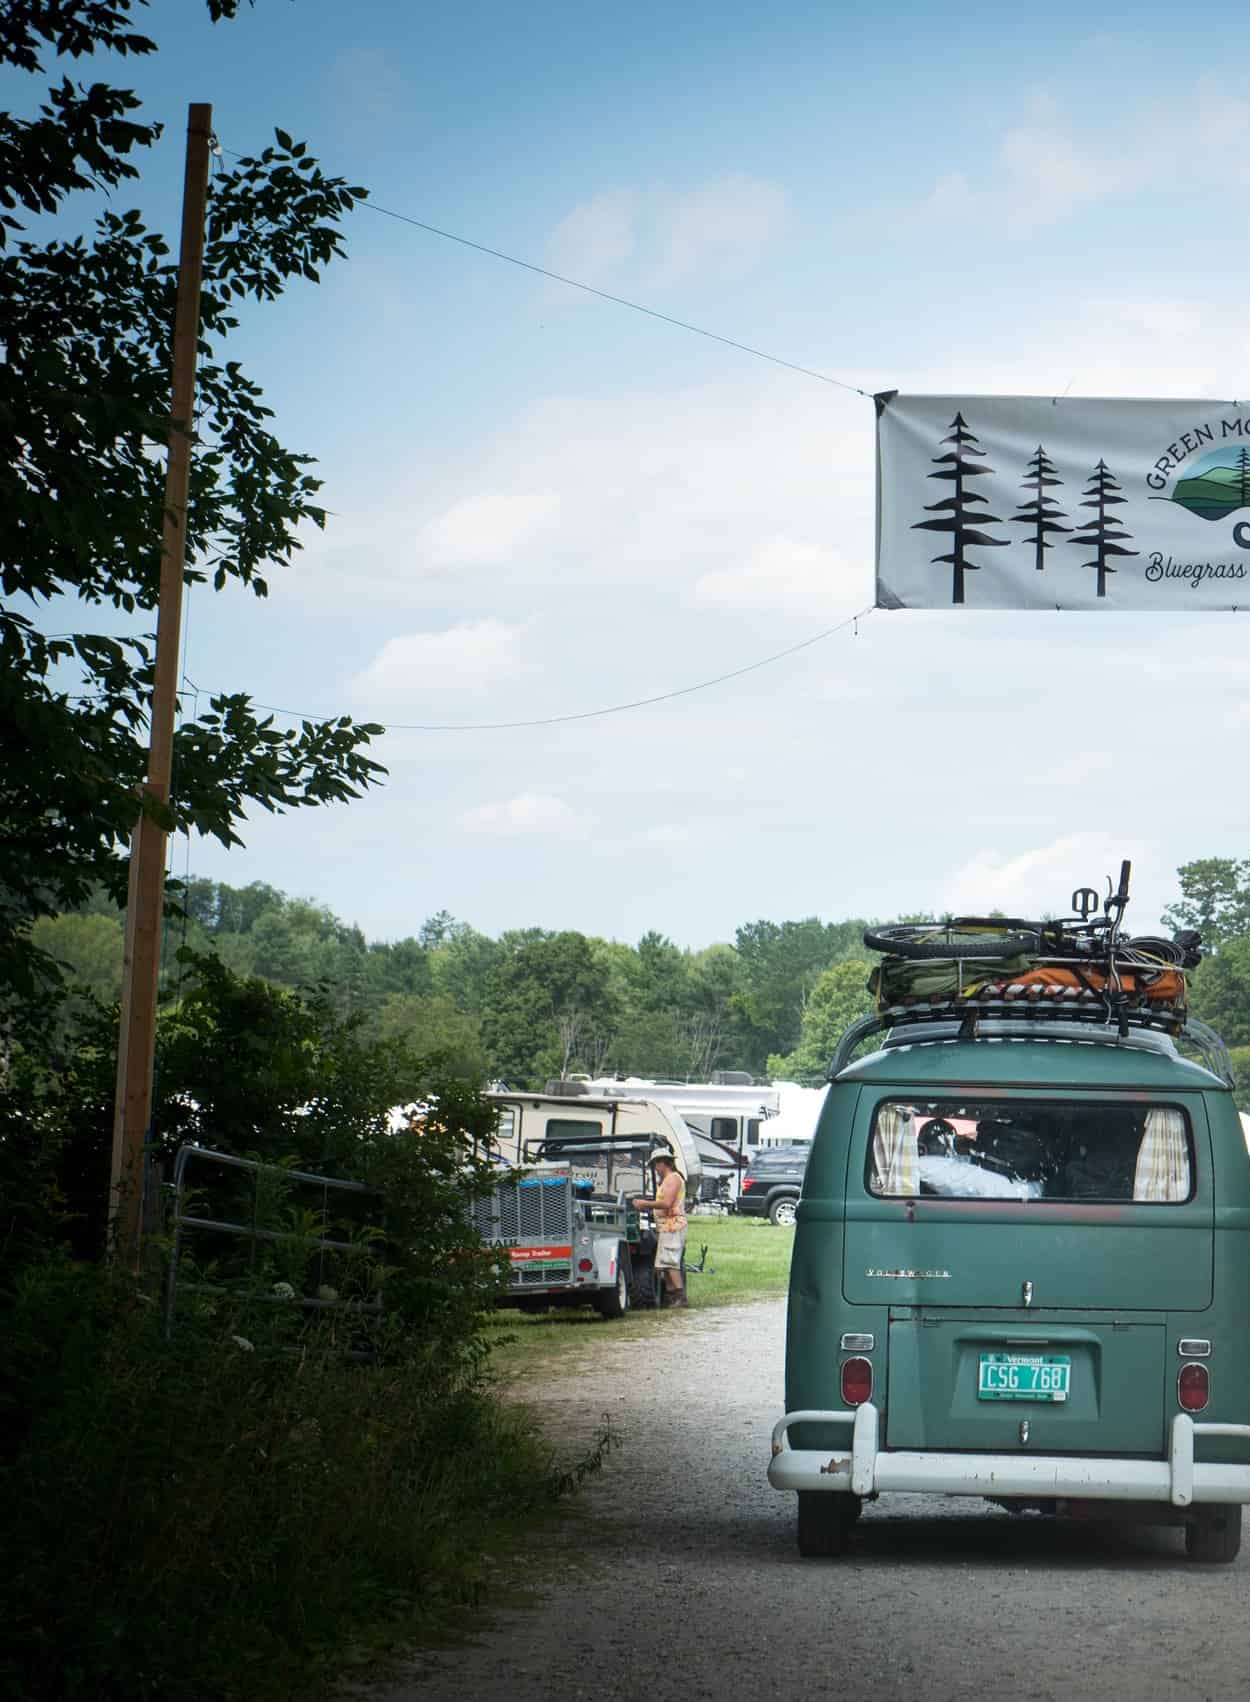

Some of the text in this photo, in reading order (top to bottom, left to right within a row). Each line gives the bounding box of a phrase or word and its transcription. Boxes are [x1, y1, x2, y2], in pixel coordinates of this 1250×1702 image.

[1146, 424, 1215, 491] GREEN
[1145, 551, 1247, 589] Bluegrass
[986, 1365, 1062, 1389] CSG 768
